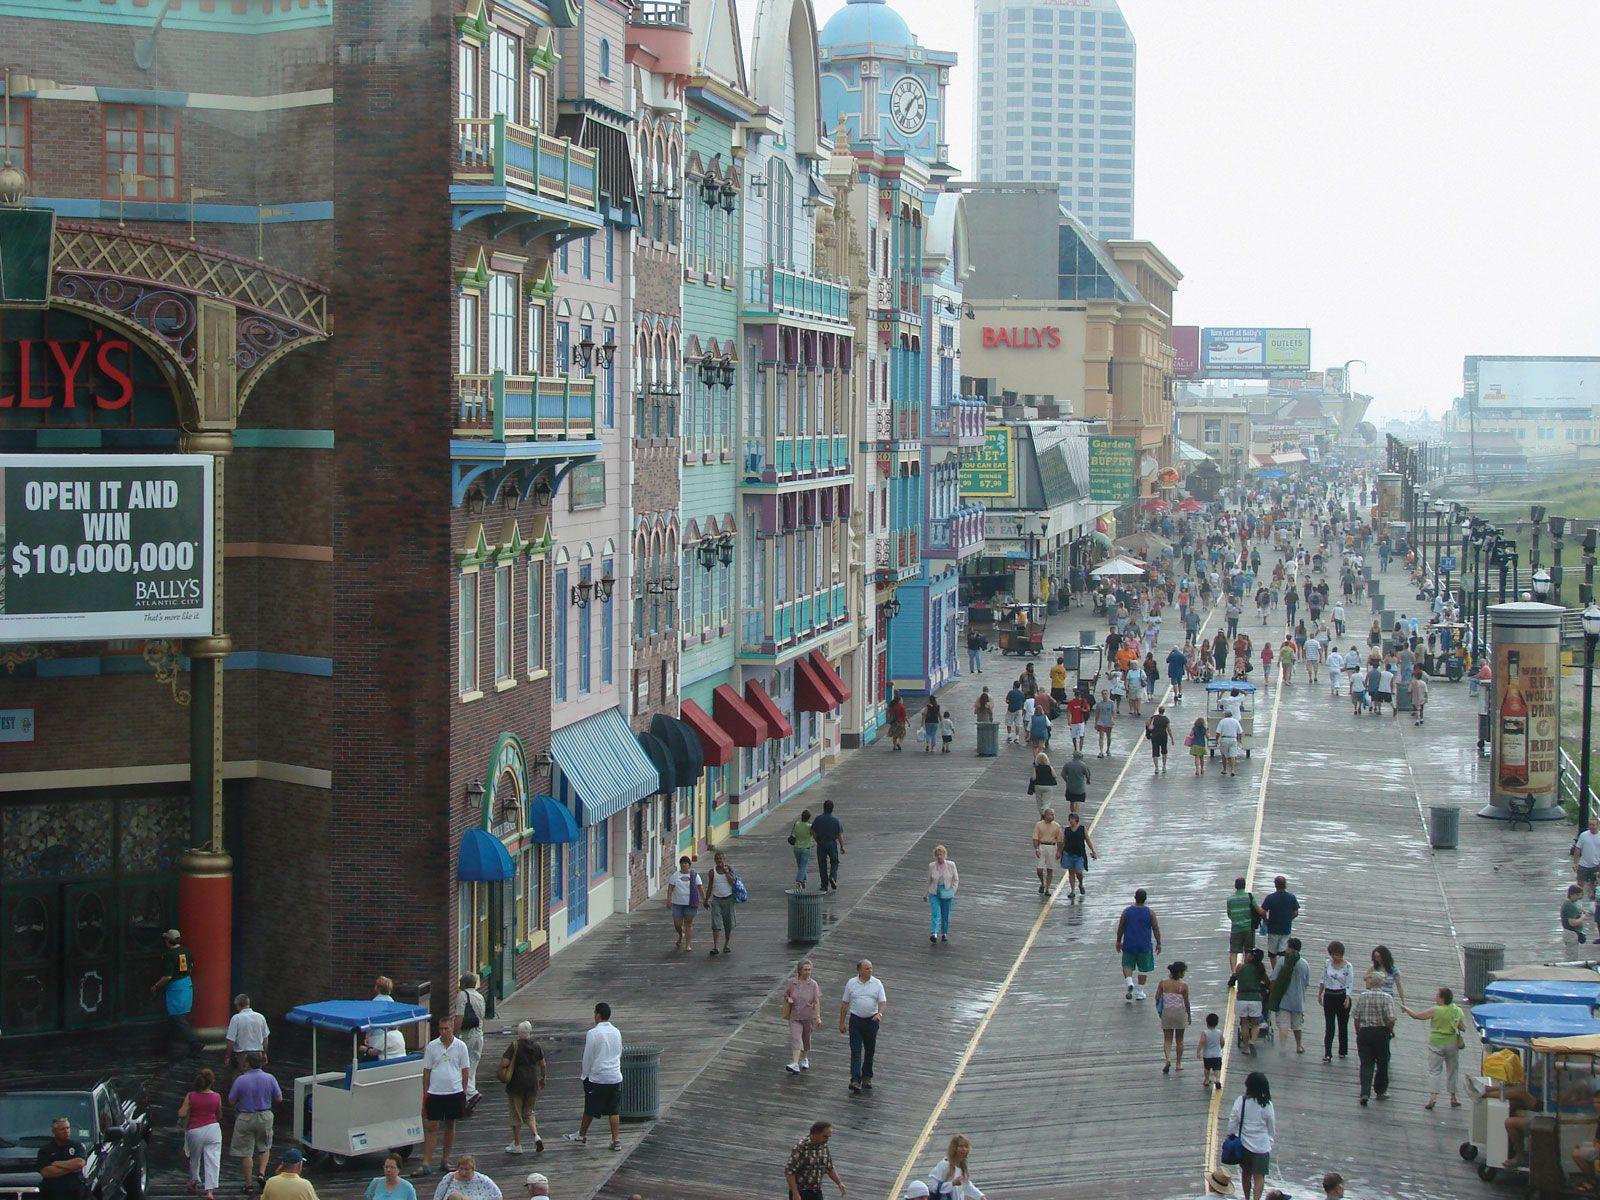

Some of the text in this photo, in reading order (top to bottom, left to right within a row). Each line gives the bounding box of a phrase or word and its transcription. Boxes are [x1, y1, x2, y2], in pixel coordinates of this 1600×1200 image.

[982, 325, 1061, 349] BALLY'S
[1223, 329, 1235, 337] Left
[1271, 339, 1303, 347] OUTLETS
[1092, 439, 1131, 449] Garden
[977, 462, 992, 470] CAN
[993, 462, 1006, 470] EAT
[1091, 456, 1133, 466] BUFFET
[25, 480, 179, 511] OPEN IT AND
[83, 512, 130, 542] WIN
[136, 578, 200, 600] BALLY'S
[1530, 677, 1555, 689] RUM
[1525, 690, 1553, 702] WOULD
[1531, 739, 1555, 752] RUM
[1531, 760, 1554, 773] RUM
